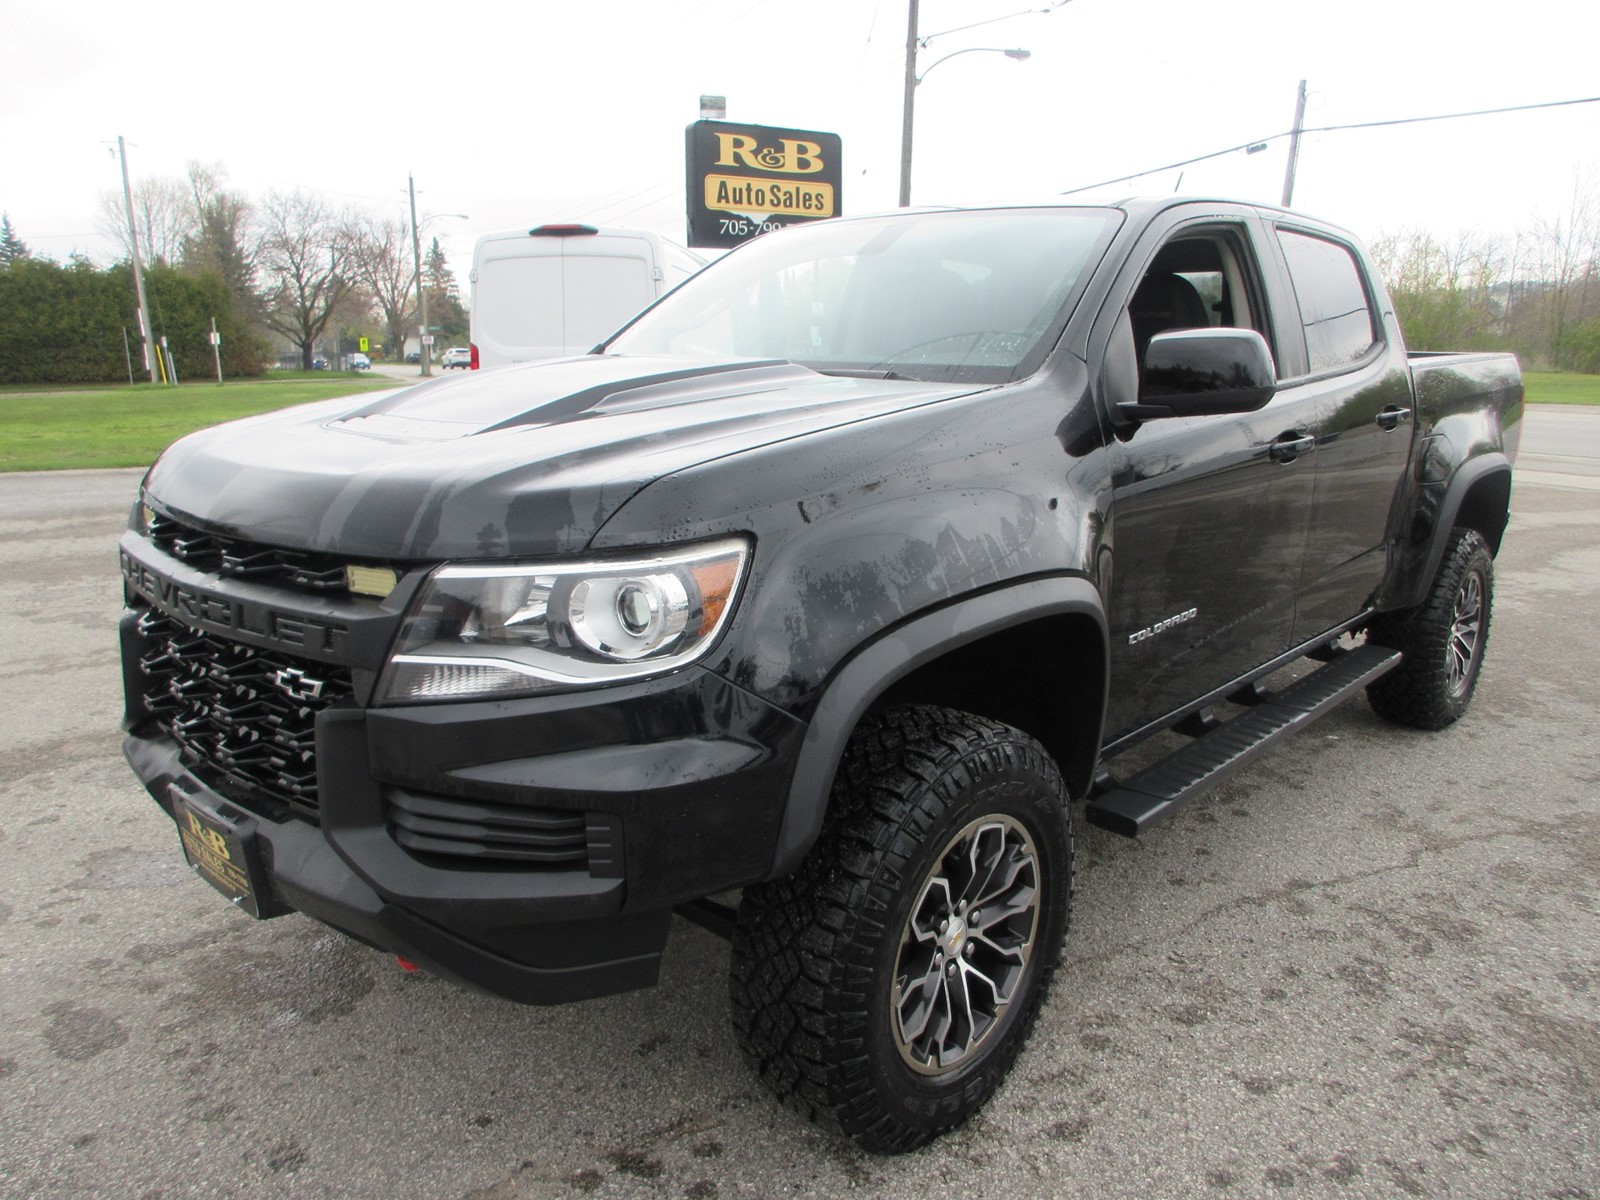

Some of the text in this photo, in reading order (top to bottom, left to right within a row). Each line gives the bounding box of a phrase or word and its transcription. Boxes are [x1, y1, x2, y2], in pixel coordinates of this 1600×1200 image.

[714, 132, 824, 174] R&B
[717, 180, 824, 211] Auto Sales
[719, 219, 796, 236] 705-799
[1128, 607, 1197, 645] COLORADO
[186, 809, 230, 860] R&B
